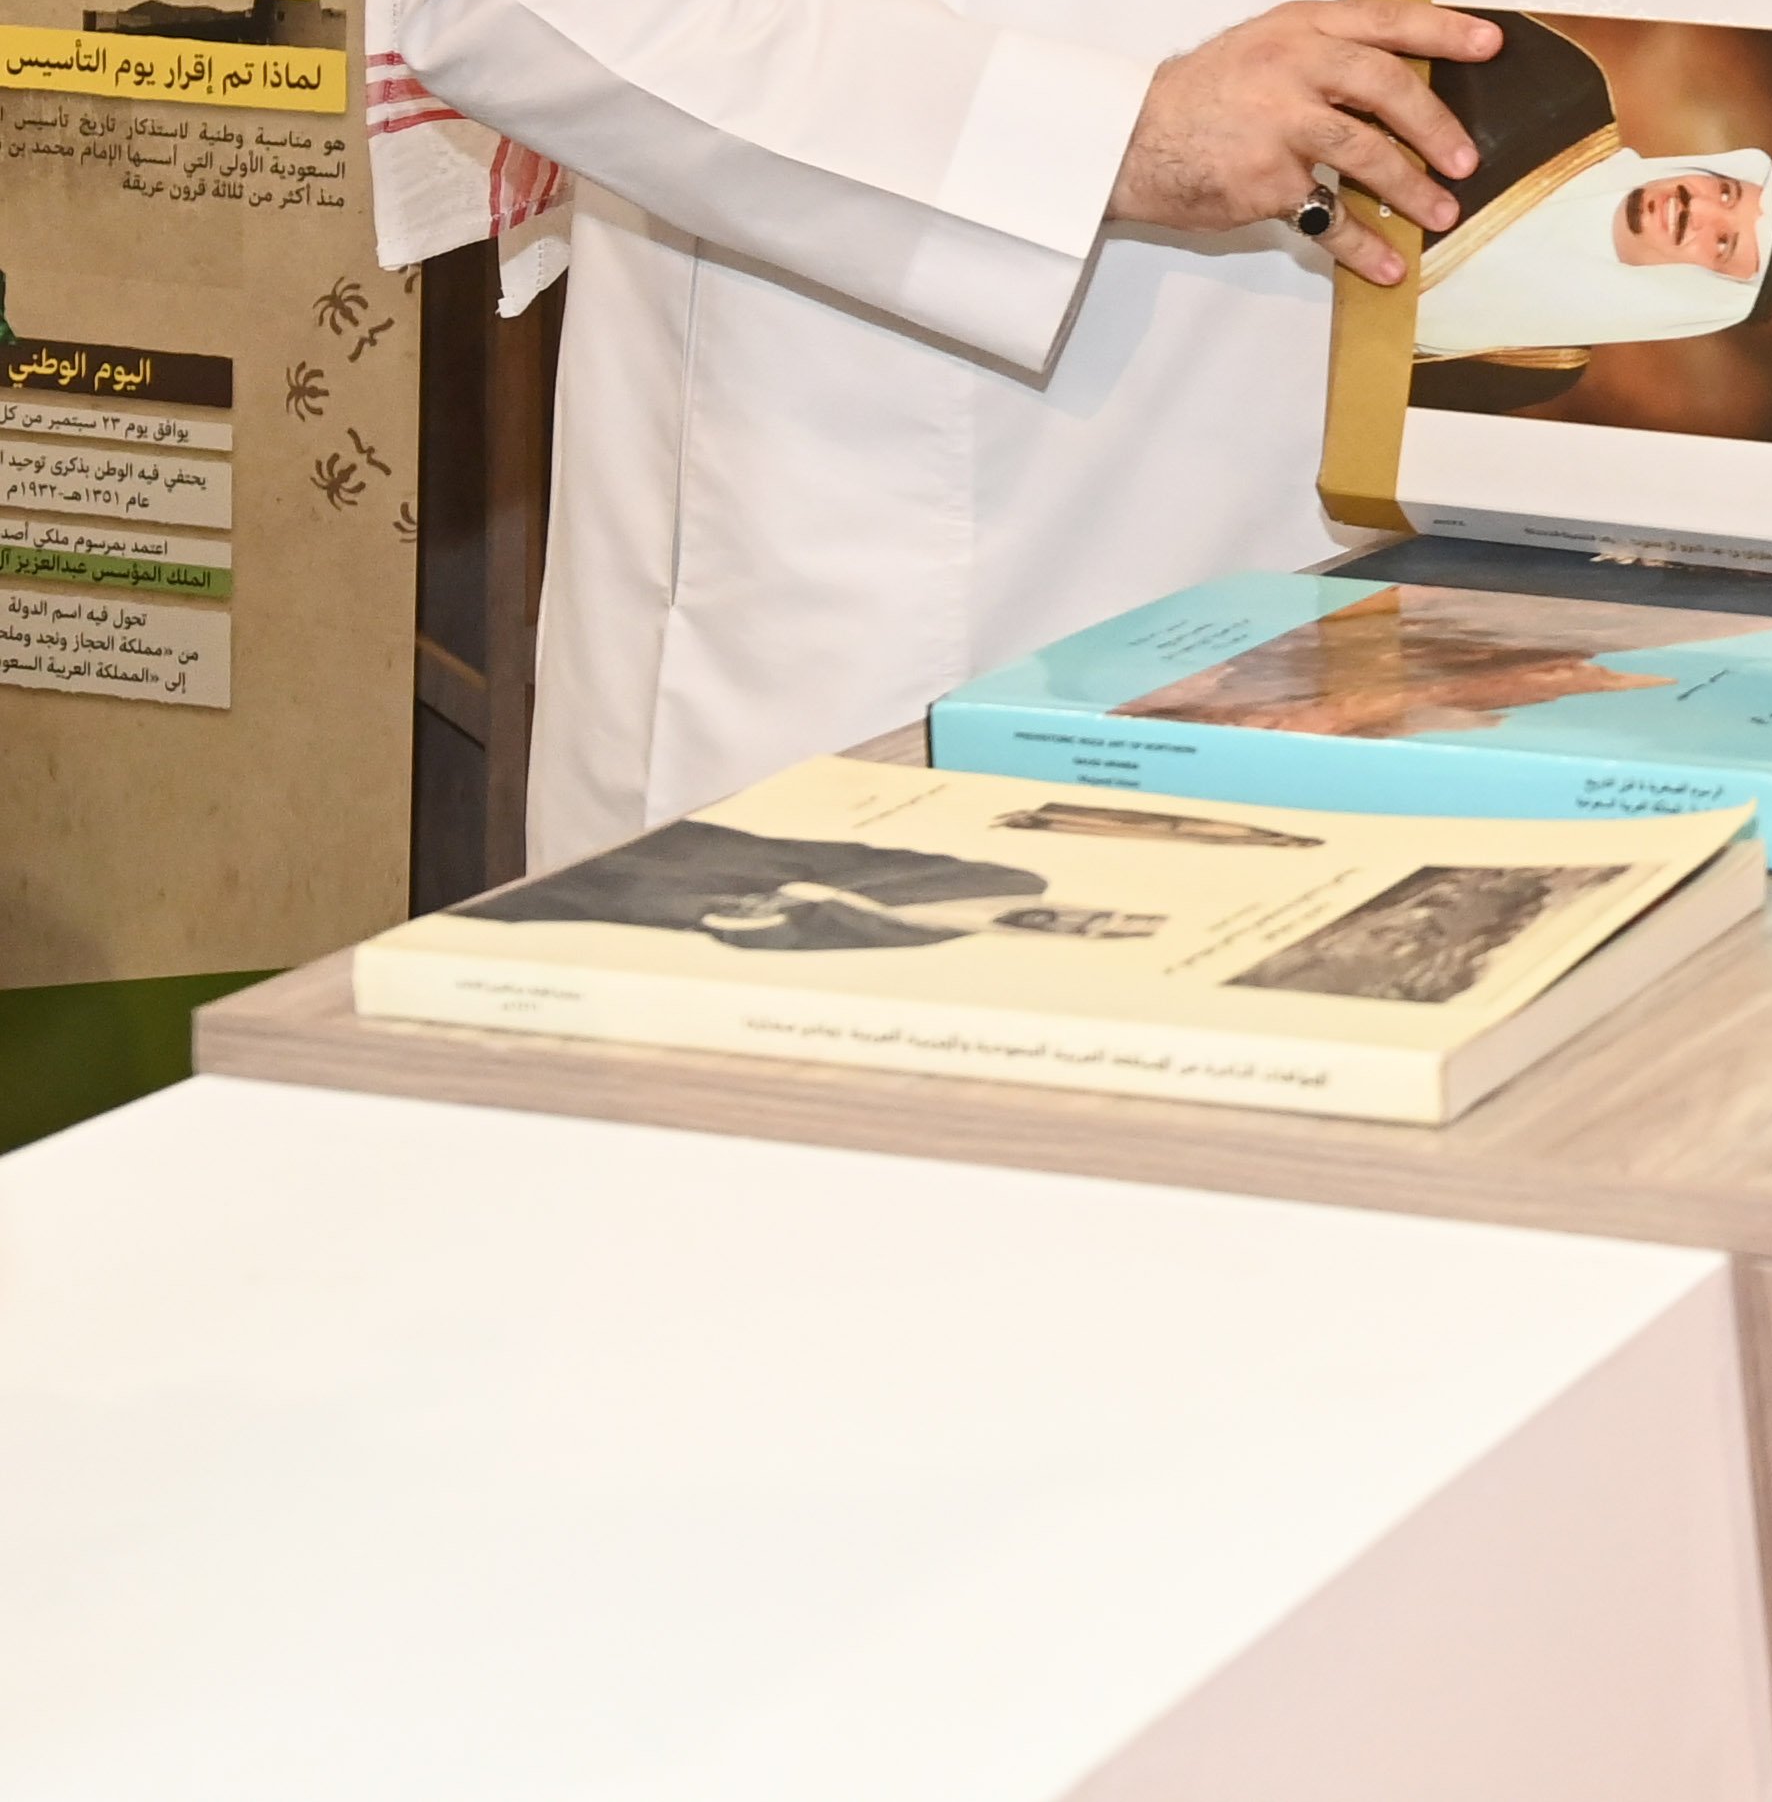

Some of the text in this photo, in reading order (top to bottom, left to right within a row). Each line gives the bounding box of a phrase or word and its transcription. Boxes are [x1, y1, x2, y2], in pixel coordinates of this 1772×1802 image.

[6, 38, 322, 96] لماذا تم إقرار يوم التأسيس
[14, 105, 346, 156] هو مناسبة وطنية لاستذكار تاريخ تأسيس
[8, 140, 345, 182] السعودية الأولى التي أسسها الإمام محمد بن
[122, 171, 345, 209] منذ أكثر من ثلاثة قرون عريقة
[8, 347, 152, 392] اليوم الوطني
[22, 415, 42, 428] من
[48, 416, 97, 432] سبتمبر
[102, 416, 121, 430] ٢٣
[124, 424, 148, 440] يوم
[152, 419, 189, 443] يوافق
[8, 454, 207, 493] يحتفي فيه الوطن بذكرى توحيد
[125, 491, 150, 513] عام
[1, 520, 168, 556] اعتمد بمرسوم ملكي أصد
[92, 562, 161, 586] المؤسس
[166, 568, 211, 588] الملك
[8, 596, 148, 630] تحول فيه اسم الدولة
[36, 630, 68, 650] ونجد
[73, 631, 115, 654] الحجاز
[0, 655, 42, 674] السعو
[46, 656, 91, 680] العربية
[178, 650, 199, 664] من
[164, 671, 187, 695] إلى
